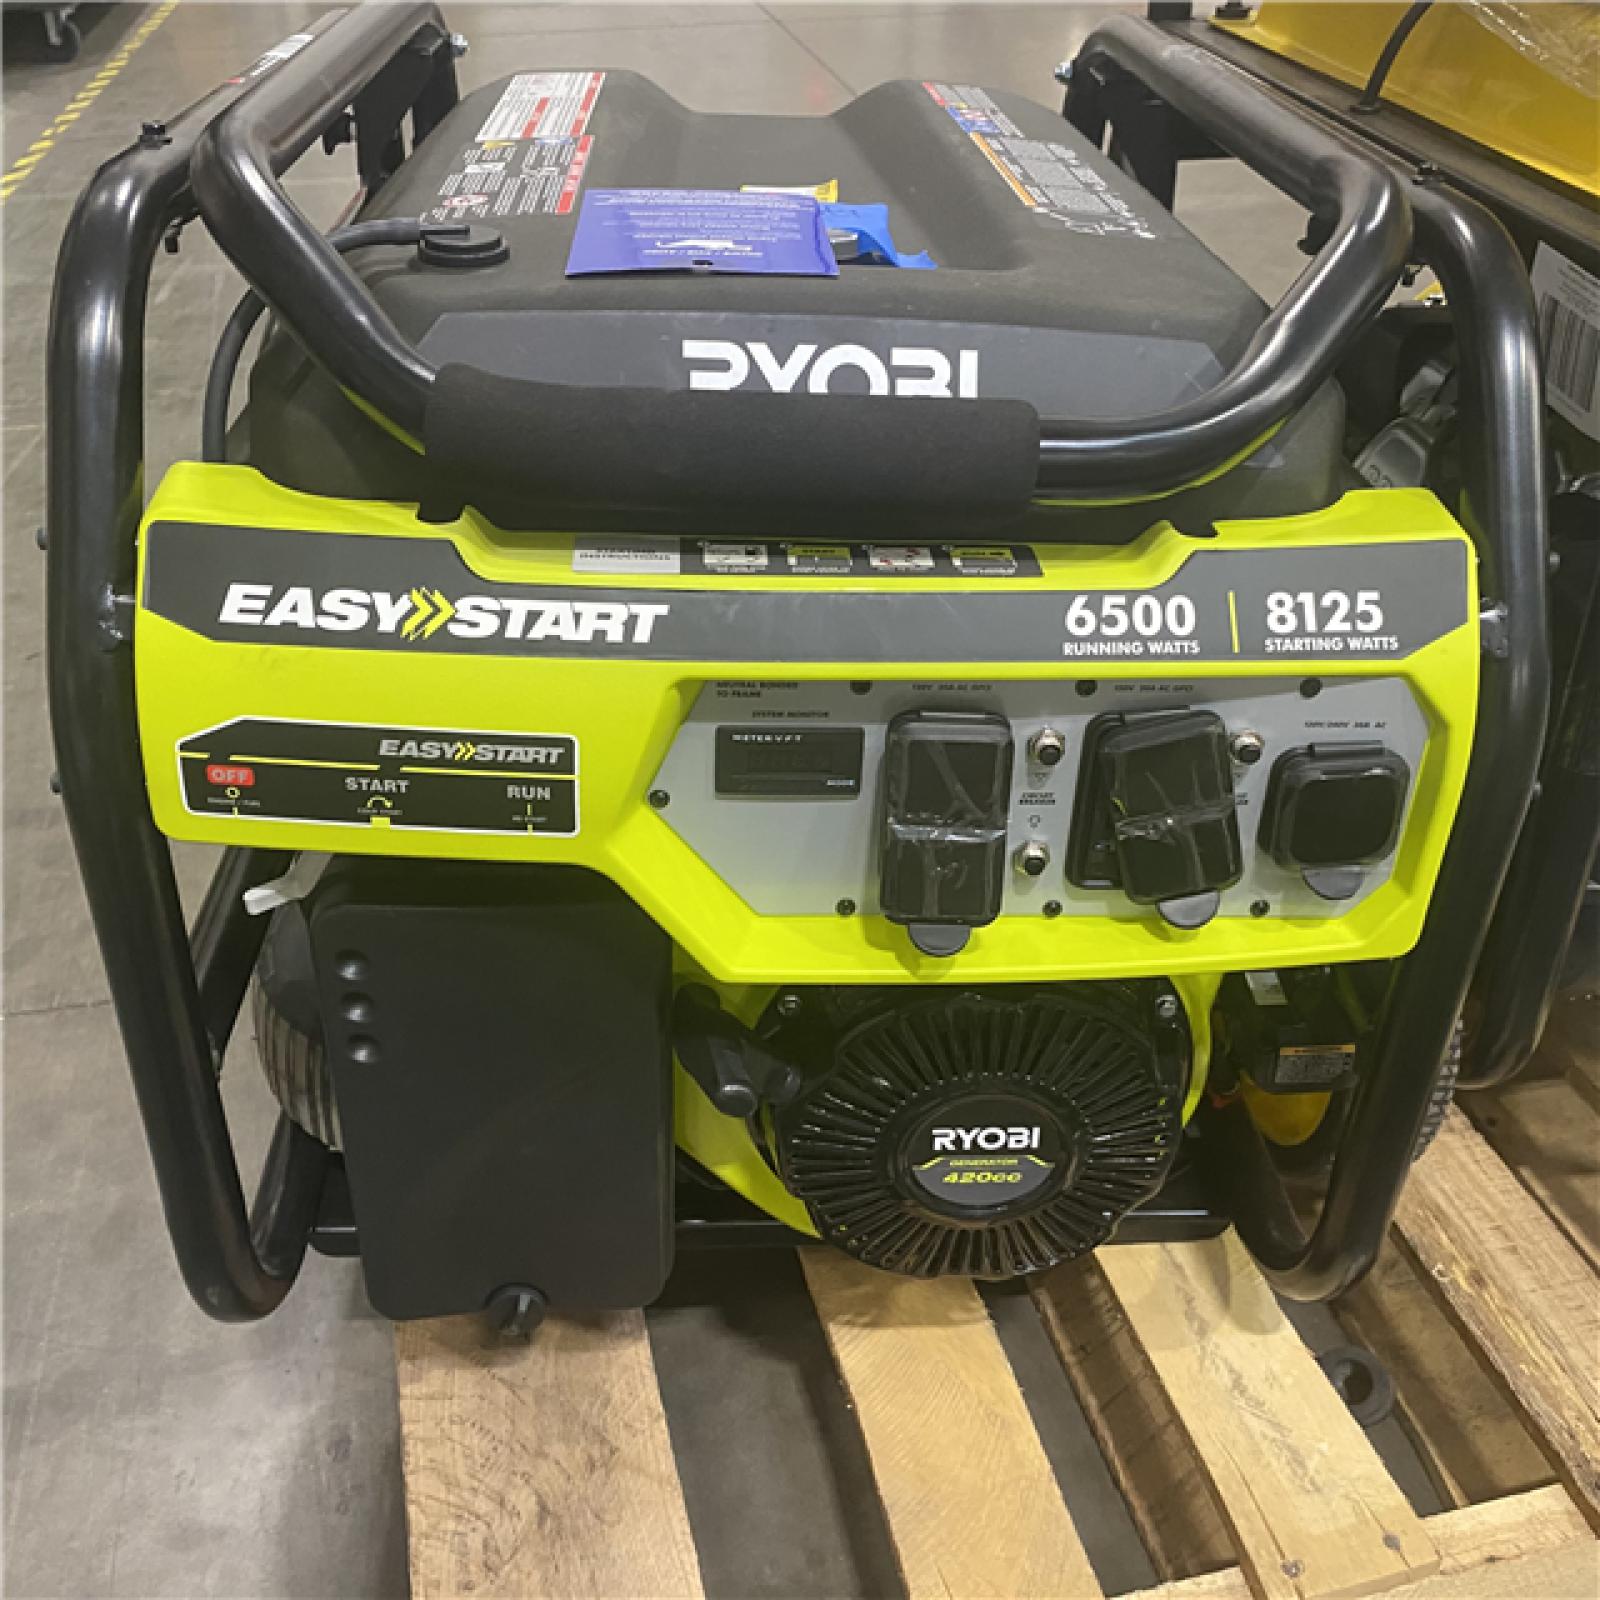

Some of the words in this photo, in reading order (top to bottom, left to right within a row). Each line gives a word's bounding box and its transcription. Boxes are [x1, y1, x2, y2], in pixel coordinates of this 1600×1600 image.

[1064, 594, 1196, 637] 6500
[1266, 590, 1384, 633] 8125
[1062, 641, 1144, 656] RUNNING
[1146, 640, 1201, 656] WATTS
[1264, 637, 1343, 653] STARTING
[1346, 635, 1399, 652] WATTS
[211, 768, 249, 783] OFF
[344, 777, 410, 793] START
[507, 784, 551, 800] RUN
[931, 1126, 1041, 1151] RYOBI
